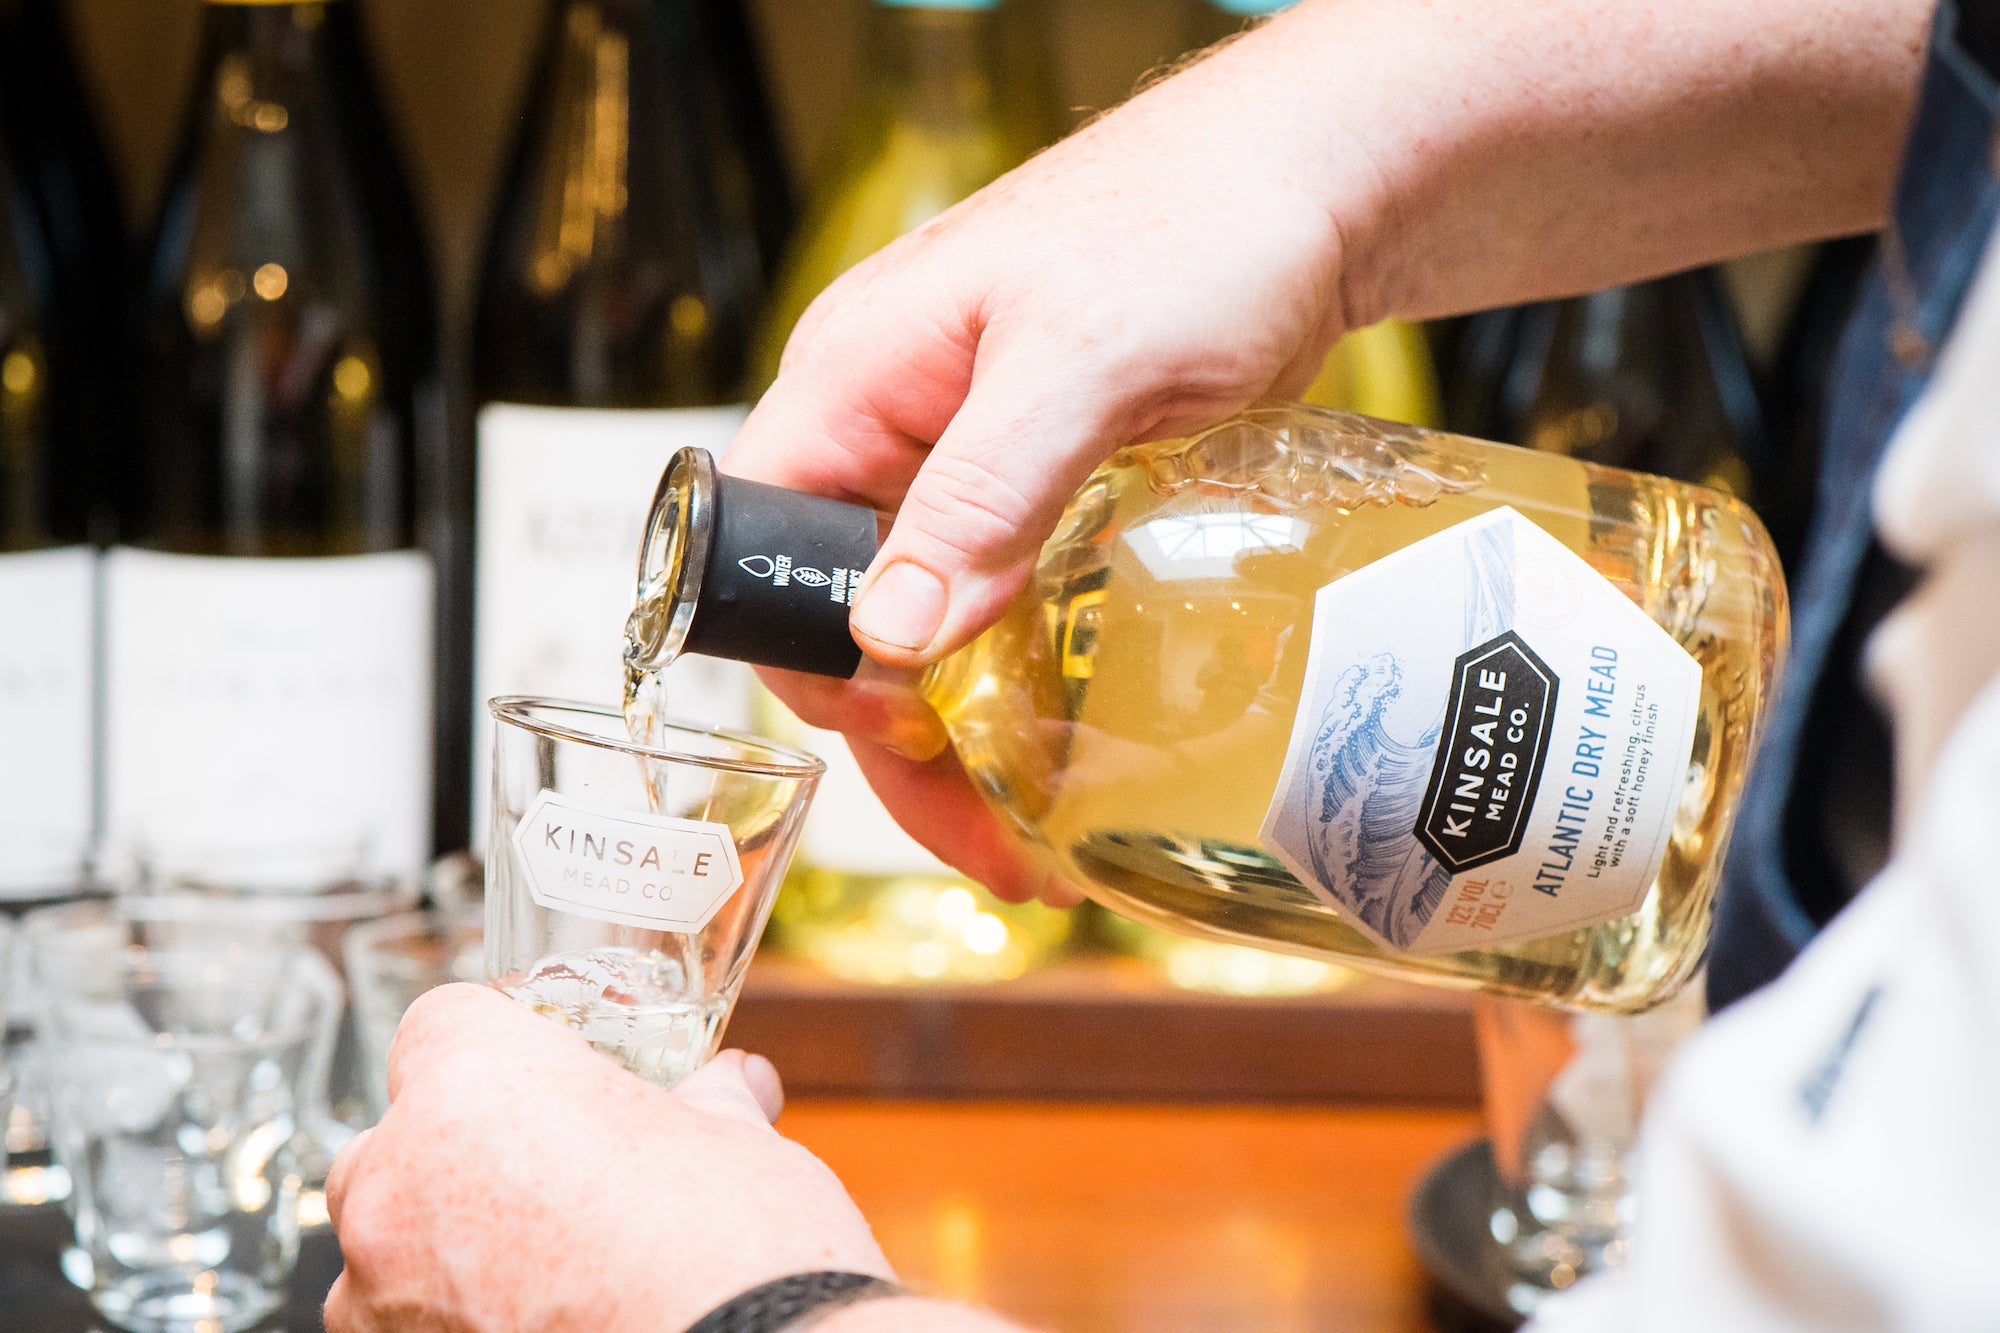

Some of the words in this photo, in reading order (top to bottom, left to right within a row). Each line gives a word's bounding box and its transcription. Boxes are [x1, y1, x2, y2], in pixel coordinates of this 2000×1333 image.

[773, 554, 792, 586] WATER
[830, 568, 848, 603] NATURAL
[1584, 646, 1618, 719] MEAD
[1644, 703, 1659, 744] finish
[1441, 667, 1507, 839] KINSALE
[1486, 756, 1518, 822] MEAD
[1506, 702, 1531, 745] CO.
[1572, 726, 1607, 777] DRY
[1632, 748, 1653, 792] honey
[1587, 845, 1609, 878] Light
[1604, 816, 1618, 842] and
[1613, 732, 1641, 813] refreshing,
[1632, 684, 1646, 726] citrus
[1625, 796, 1640, 823] soft
[545, 823, 712, 877] KINSALE
[1532, 786, 1593, 897] ATLANTIC
[1610, 839, 1627, 867] with
[563, 866, 630, 894] MEAD
[1458, 879, 1489, 902] VOL
